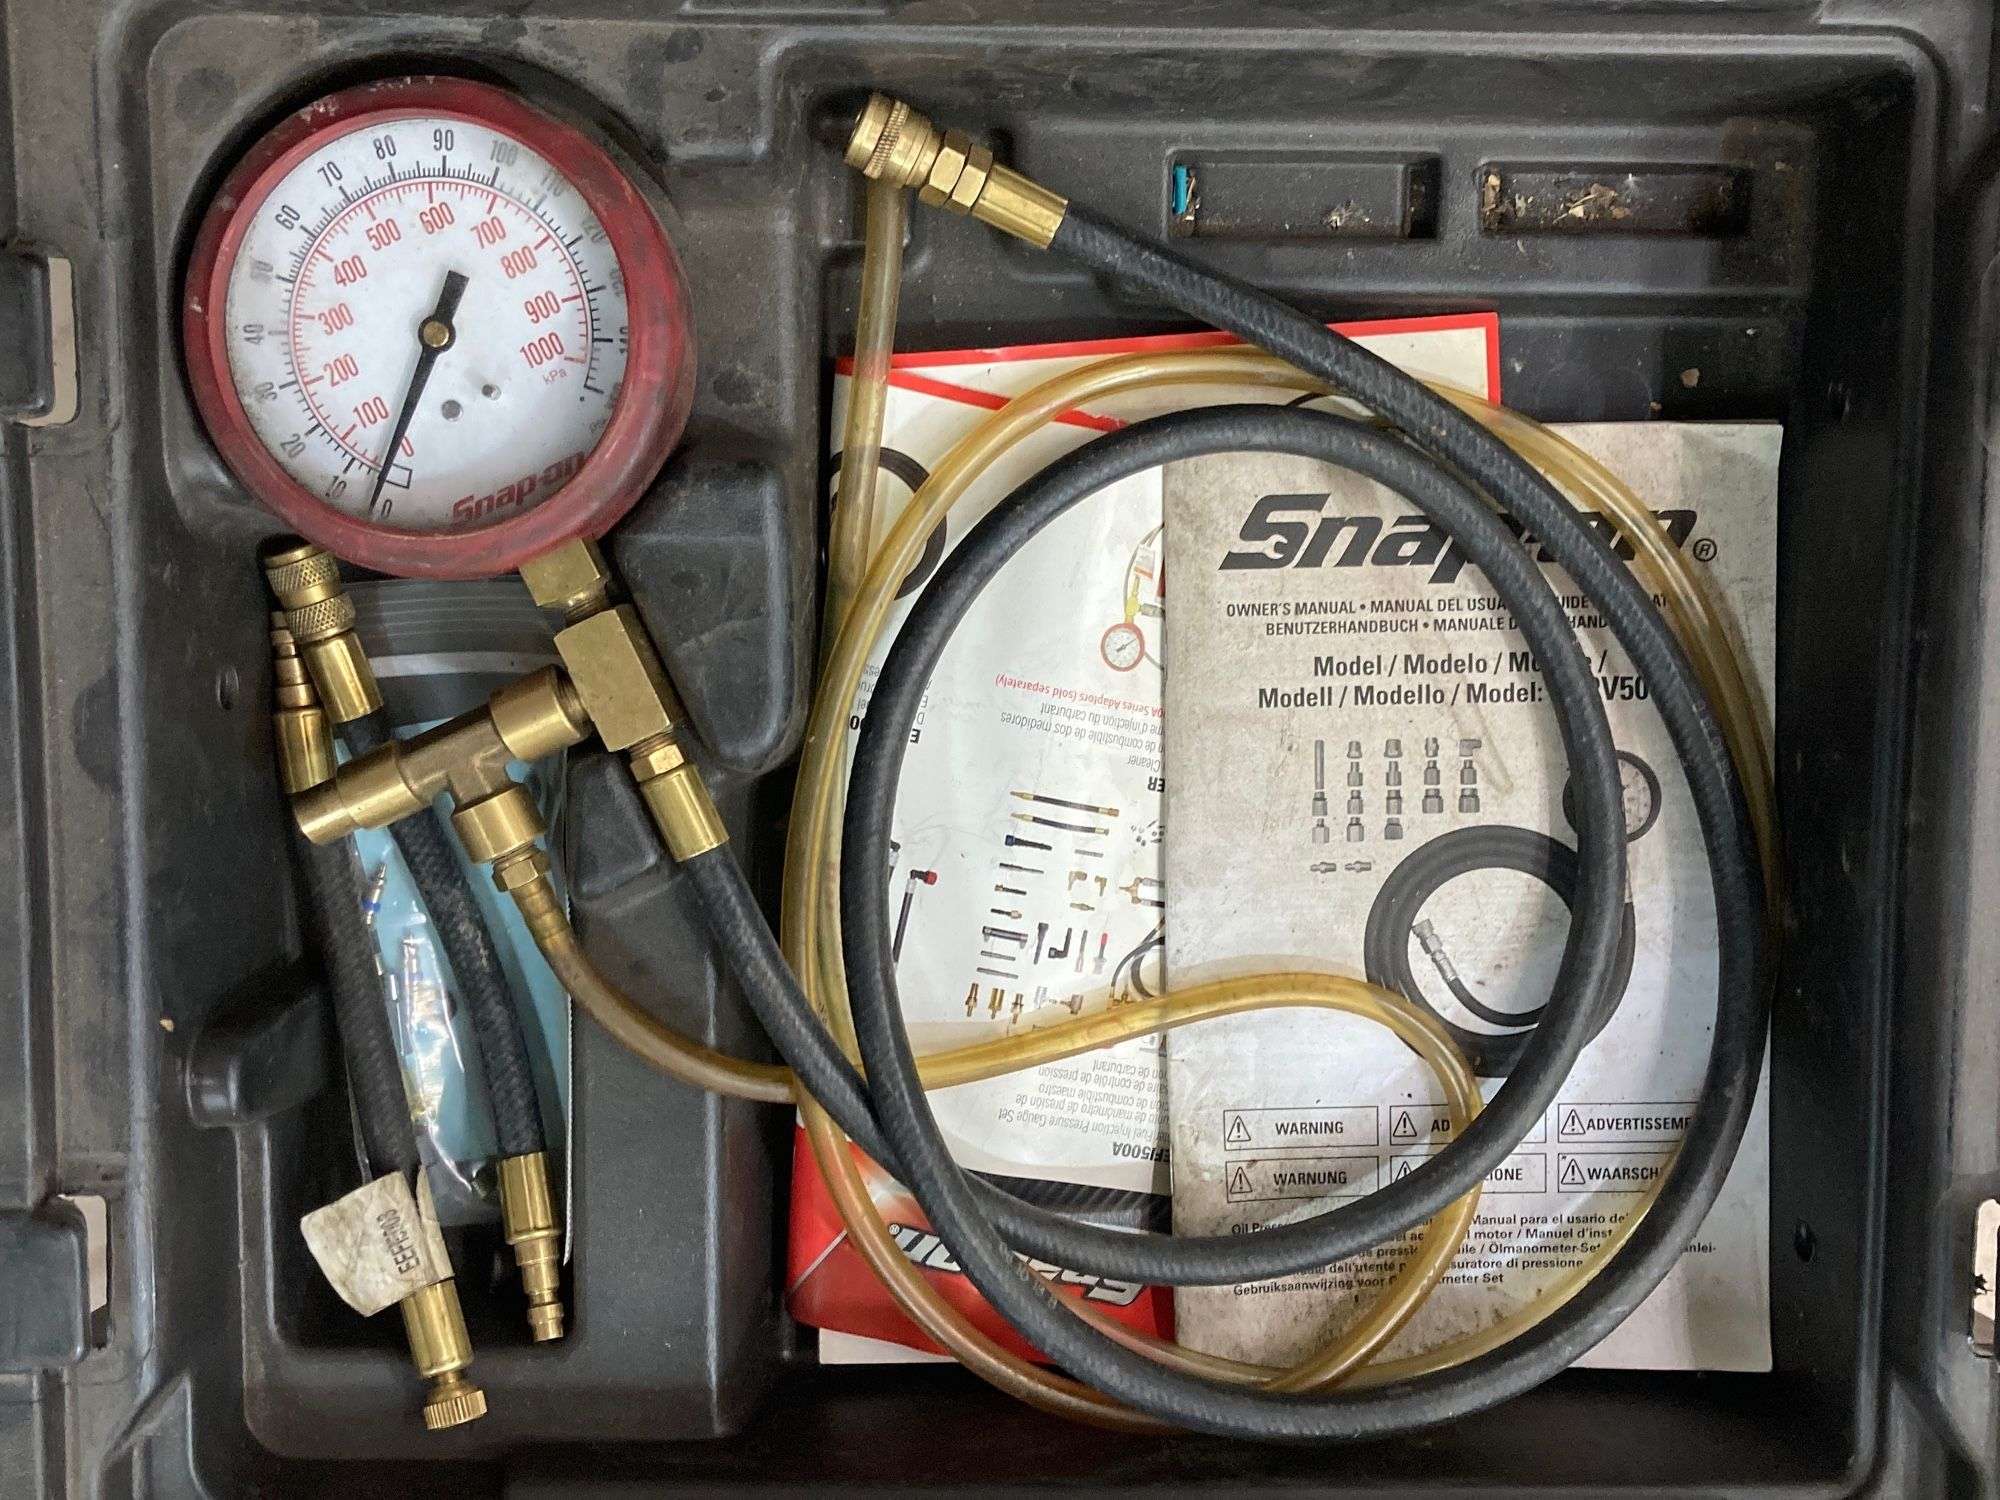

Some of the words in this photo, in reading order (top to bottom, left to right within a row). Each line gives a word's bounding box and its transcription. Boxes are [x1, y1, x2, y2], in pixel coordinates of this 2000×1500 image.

[373, 135, 397, 158] 80
[433, 129, 454, 151] 90
[489, 140, 517, 167] 100
[317, 161, 343, 183] 70
[275, 204, 301, 231] 60
[419, 202, 455, 234] 600
[366, 218, 401, 251] 500
[471, 216, 506, 249] 700
[333, 254, 367, 287] 400
[500, 245, 538, 280] 800
[524, 290, 561, 324] 900
[318, 303, 354, 335] 300
[243, 323, 264, 345] 40
[519, 332, 564, 369] 1000
[323, 354, 359, 387] 200
[542, 367, 568, 385] kPa
[352, 396, 390, 429] 100
[280, 433, 306, 459] 20
[325, 475, 348, 498] 10
[380, 499, 393, 519] 0
[1227, 600, 1291, 617] OWNER'S
[1294, 599, 1356, 615] MANUAL
[1370, 598, 1434, 614] MANUAL
[1437, 598, 1463, 613] DEL
[1265, 619, 1418, 636] BENUTZERHANDBUCH
[1433, 616, 1504, 632] MANUALE
[1313, 655, 1382, 676] Model
[1403, 653, 1487, 675] Modelo
[1258, 686, 1333, 709] Modell
[1354, 684, 1445, 707] Modello
[1466, 682, 1543, 705] Model:
[1001, 712, 1050, 731] medidores
[1040, 702, 1087, 720] carburant
[1089, 712, 1101, 724] du
[1055, 723, 1072, 735] dos
[1075, 727, 1086, 738] de
[1088, 730, 1143, 749] combustible
[1145, 740, 1156, 752] de
[1128, 754, 1161, 772] Cleaner
[1275, 1120, 1344, 1136] WARNING
[1273, 1169, 1348, 1185] WARNUNG
[1520, 1215, 1548, 1228] para
[1552, 1213, 1563, 1224] el
[1567, 1213, 1605, 1224] usario
[1609, 1212, 1629, 1224] de
[1474, 1228, 1512, 1239] motor
[1526, 1228, 1573, 1239] Manuel
[1506, 1258, 1518, 1267] di
[1233, 1278, 1353, 1296] Gebruiksaanwijzing
[1358, 1276, 1385, 1287] voor
[1482, 1272, 1504, 1283] Set
